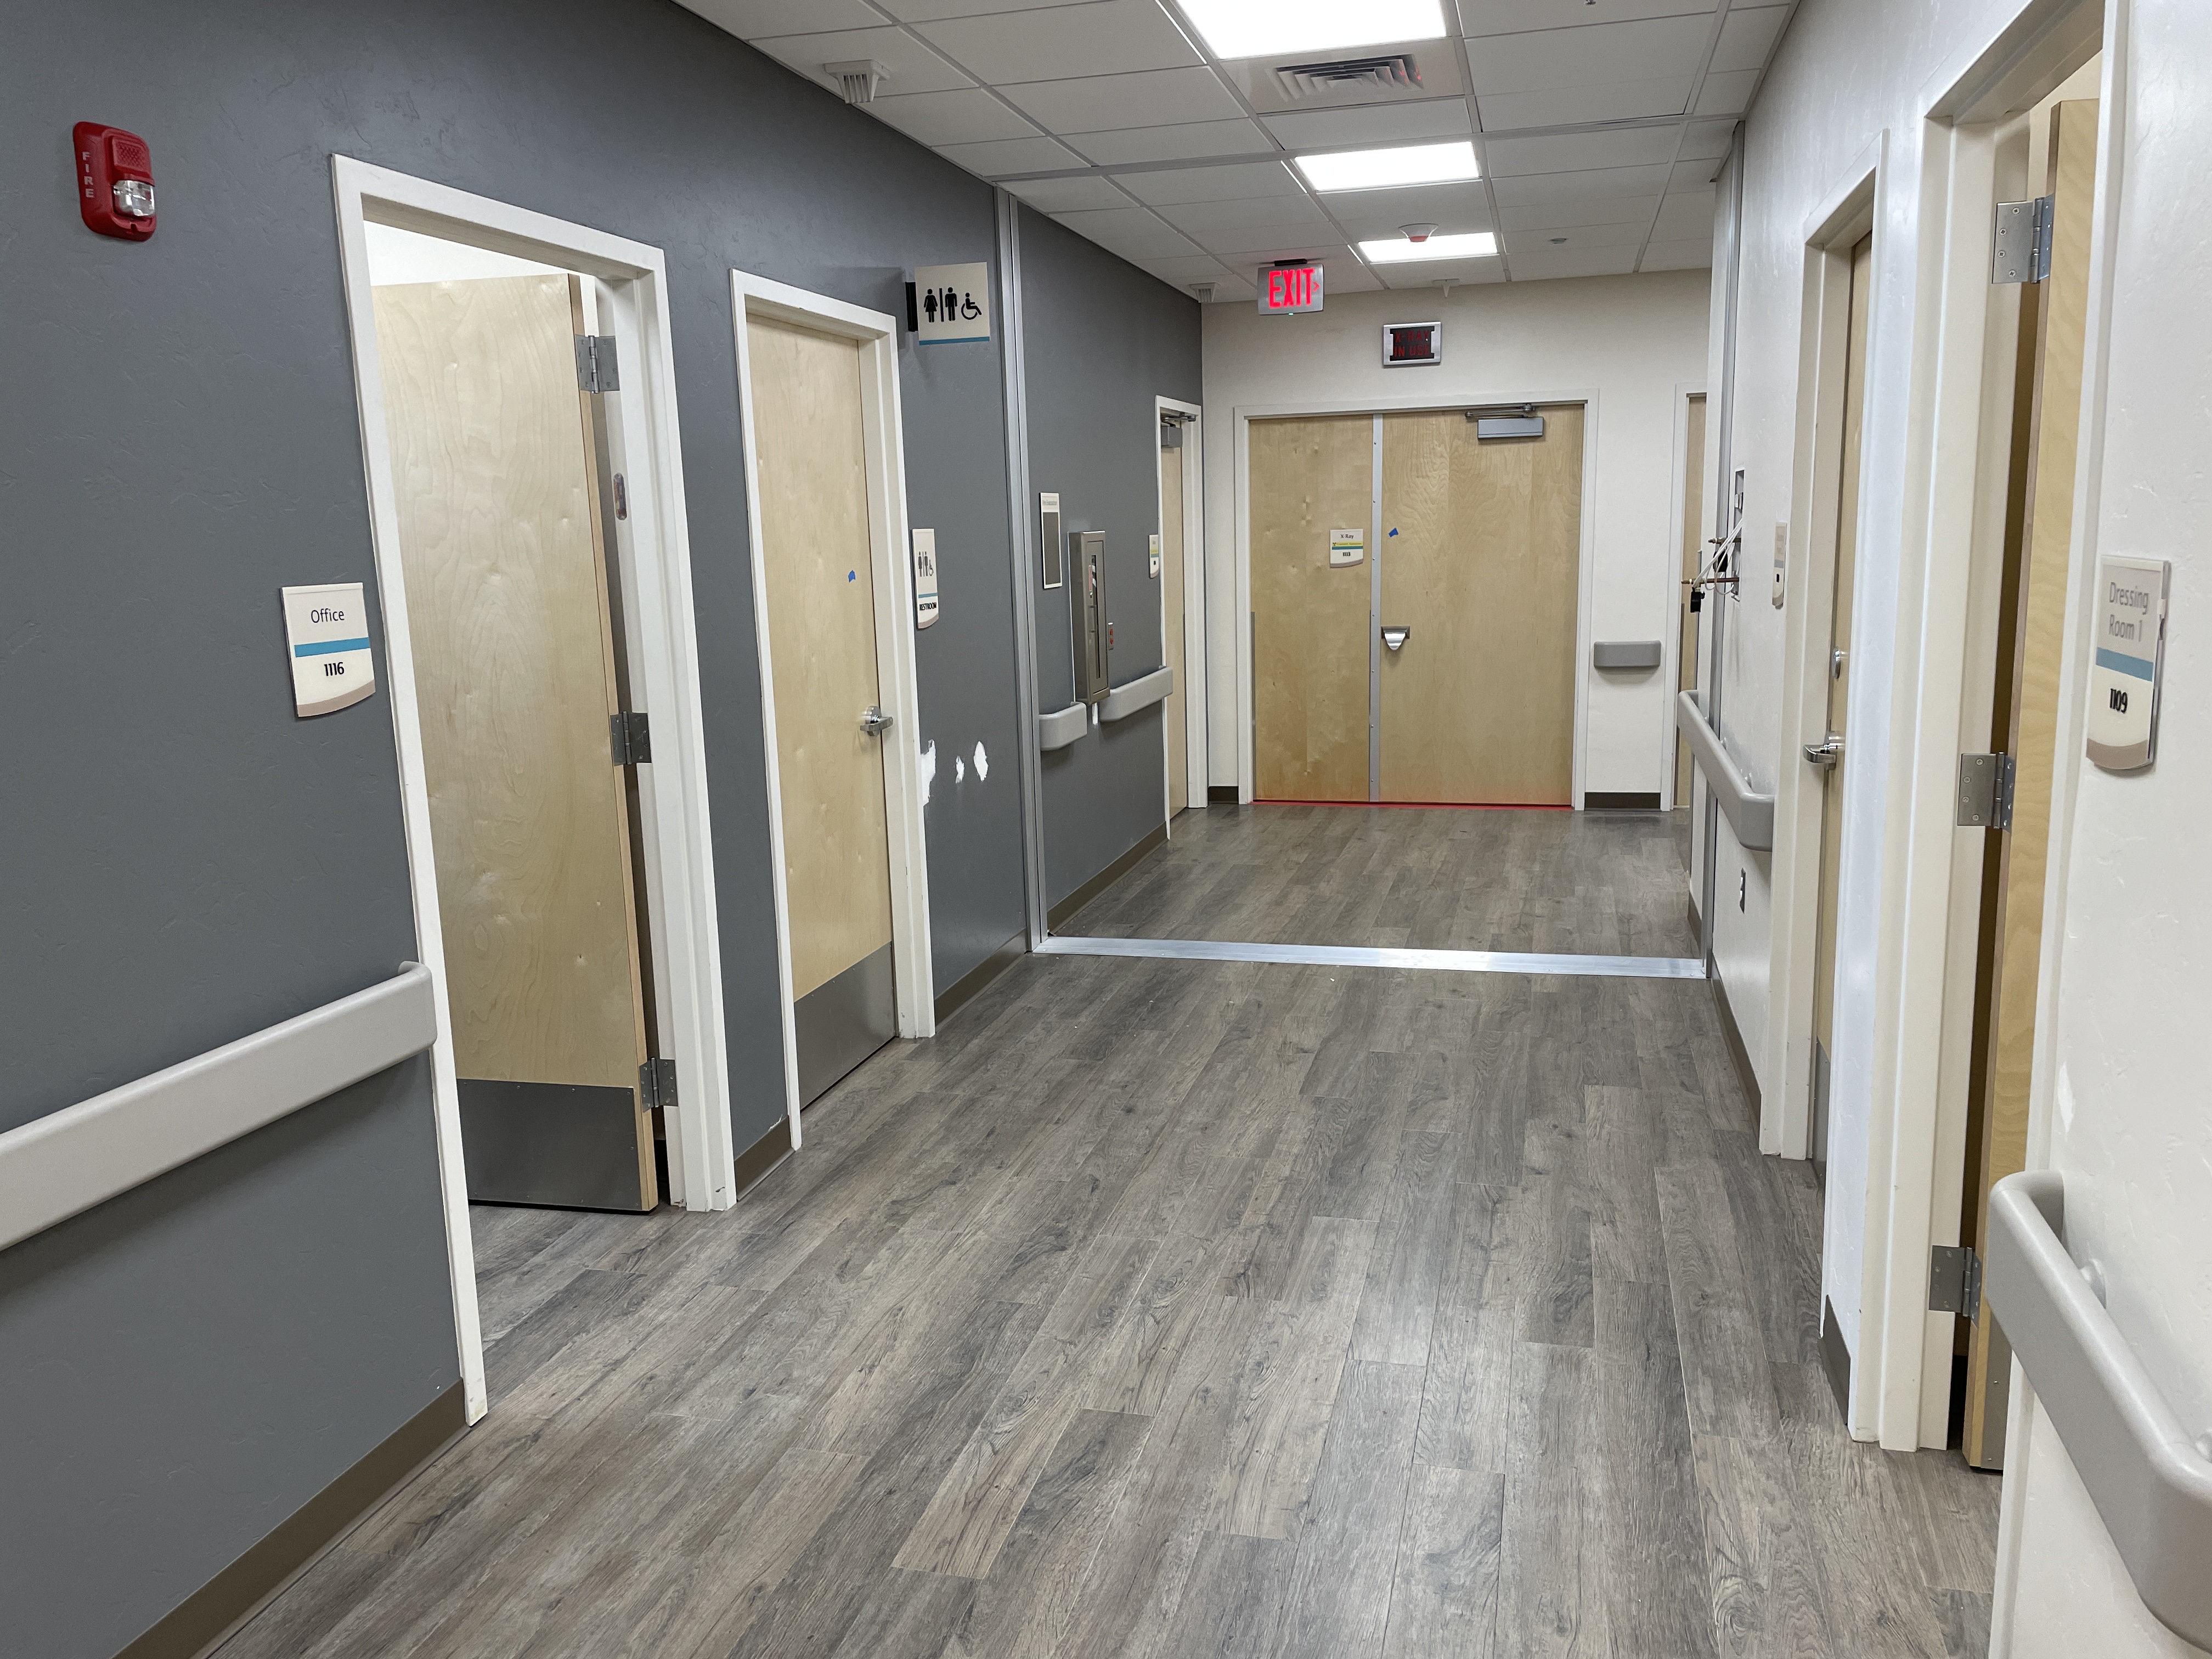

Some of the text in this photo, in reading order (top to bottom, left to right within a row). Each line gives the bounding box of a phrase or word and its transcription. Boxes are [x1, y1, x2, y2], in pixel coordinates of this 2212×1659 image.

[81, 151, 95, 199] FIRE
[1268, 268, 1316, 309] EXIT
[1395, 330, 1430, 343] X-RAY
[1393, 344, 1431, 358] IN USE
[919, 602, 937, 611] RESTROOM
[2109, 582, 2149, 615] Dressing
[311, 608, 345, 623] Office
[2109, 614, 2143, 642] Room 1
[324, 662, 345, 676] 1116
[2109, 688, 2129, 714] 1109
